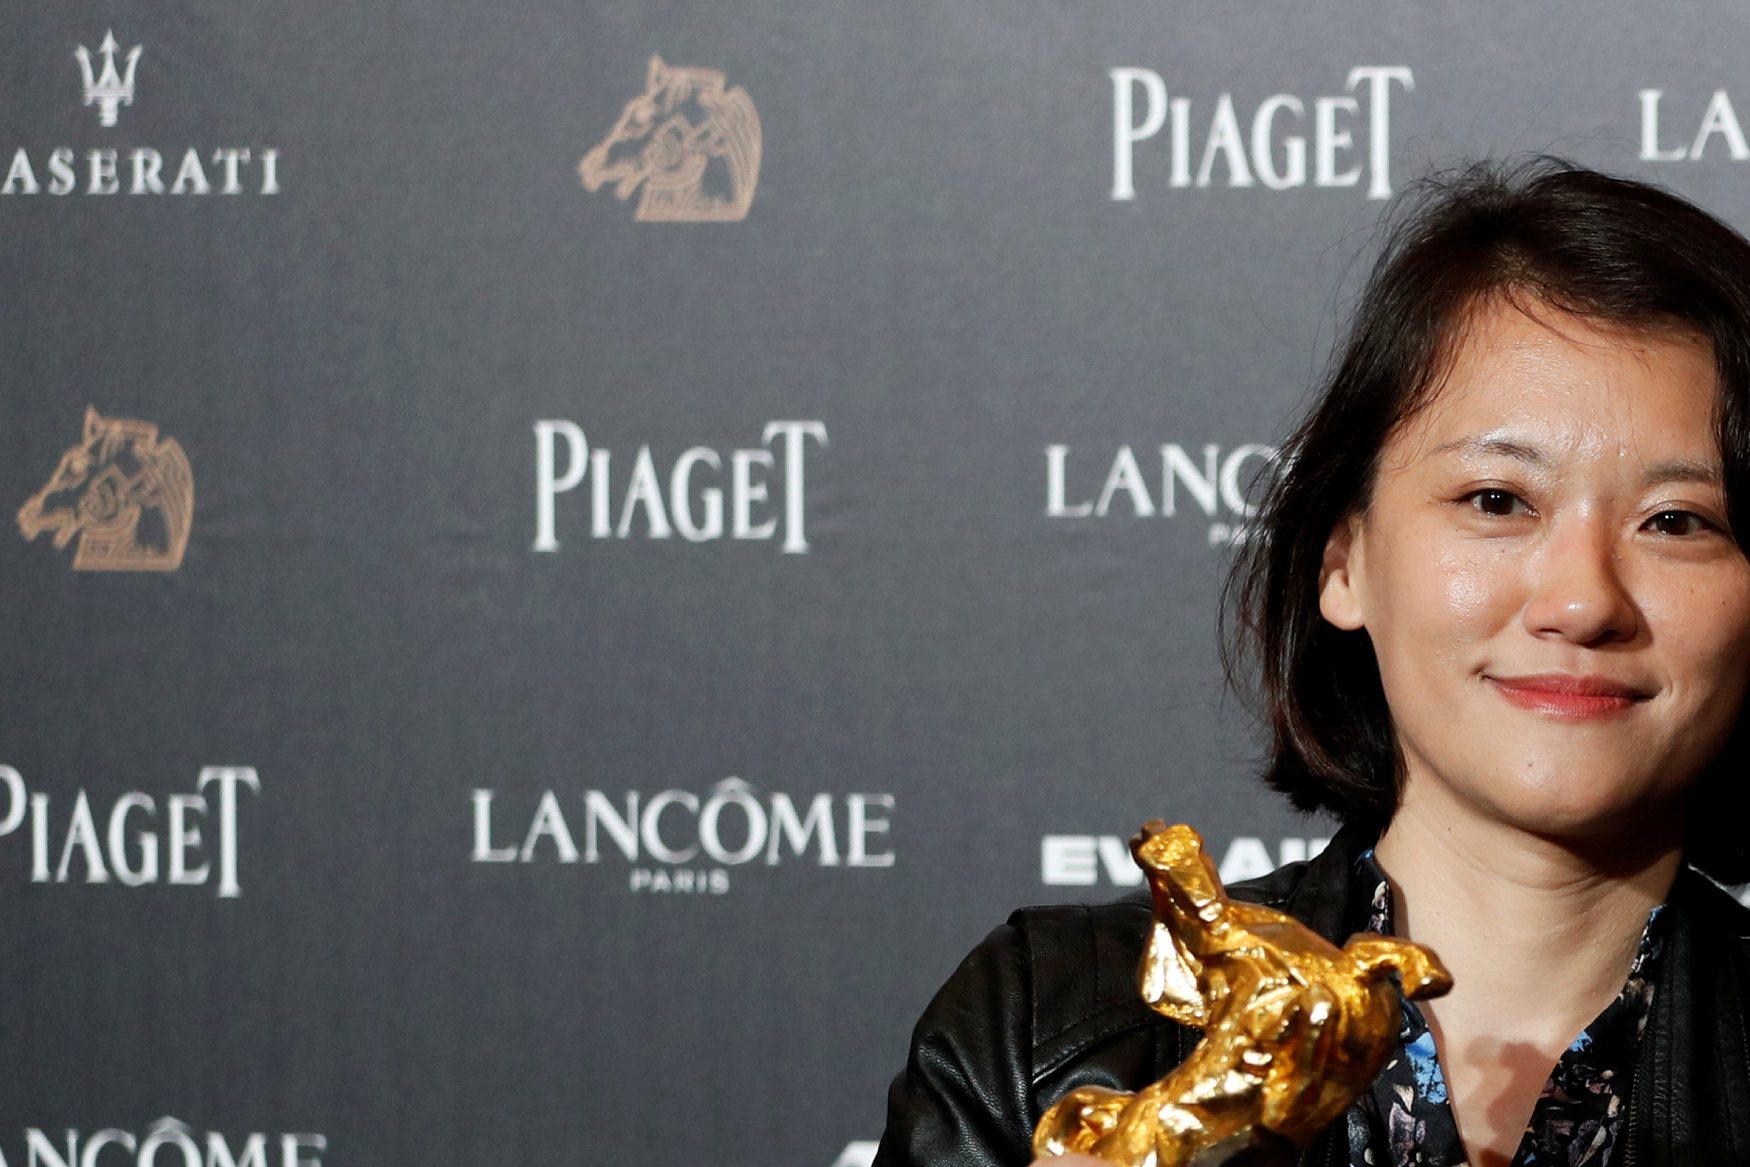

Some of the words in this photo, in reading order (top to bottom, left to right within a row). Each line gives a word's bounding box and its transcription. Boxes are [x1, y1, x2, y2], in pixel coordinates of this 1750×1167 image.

[0, 146, 281, 196] ASERATI
[1108, 64, 1416, 201] PIAGET
[532, 418, 829, 554] PIAGET
[1045, 442, 1300, 518] LANC
[471, 775, 897, 867] LANCÔME
[629, 868, 730, 895] PARIS
